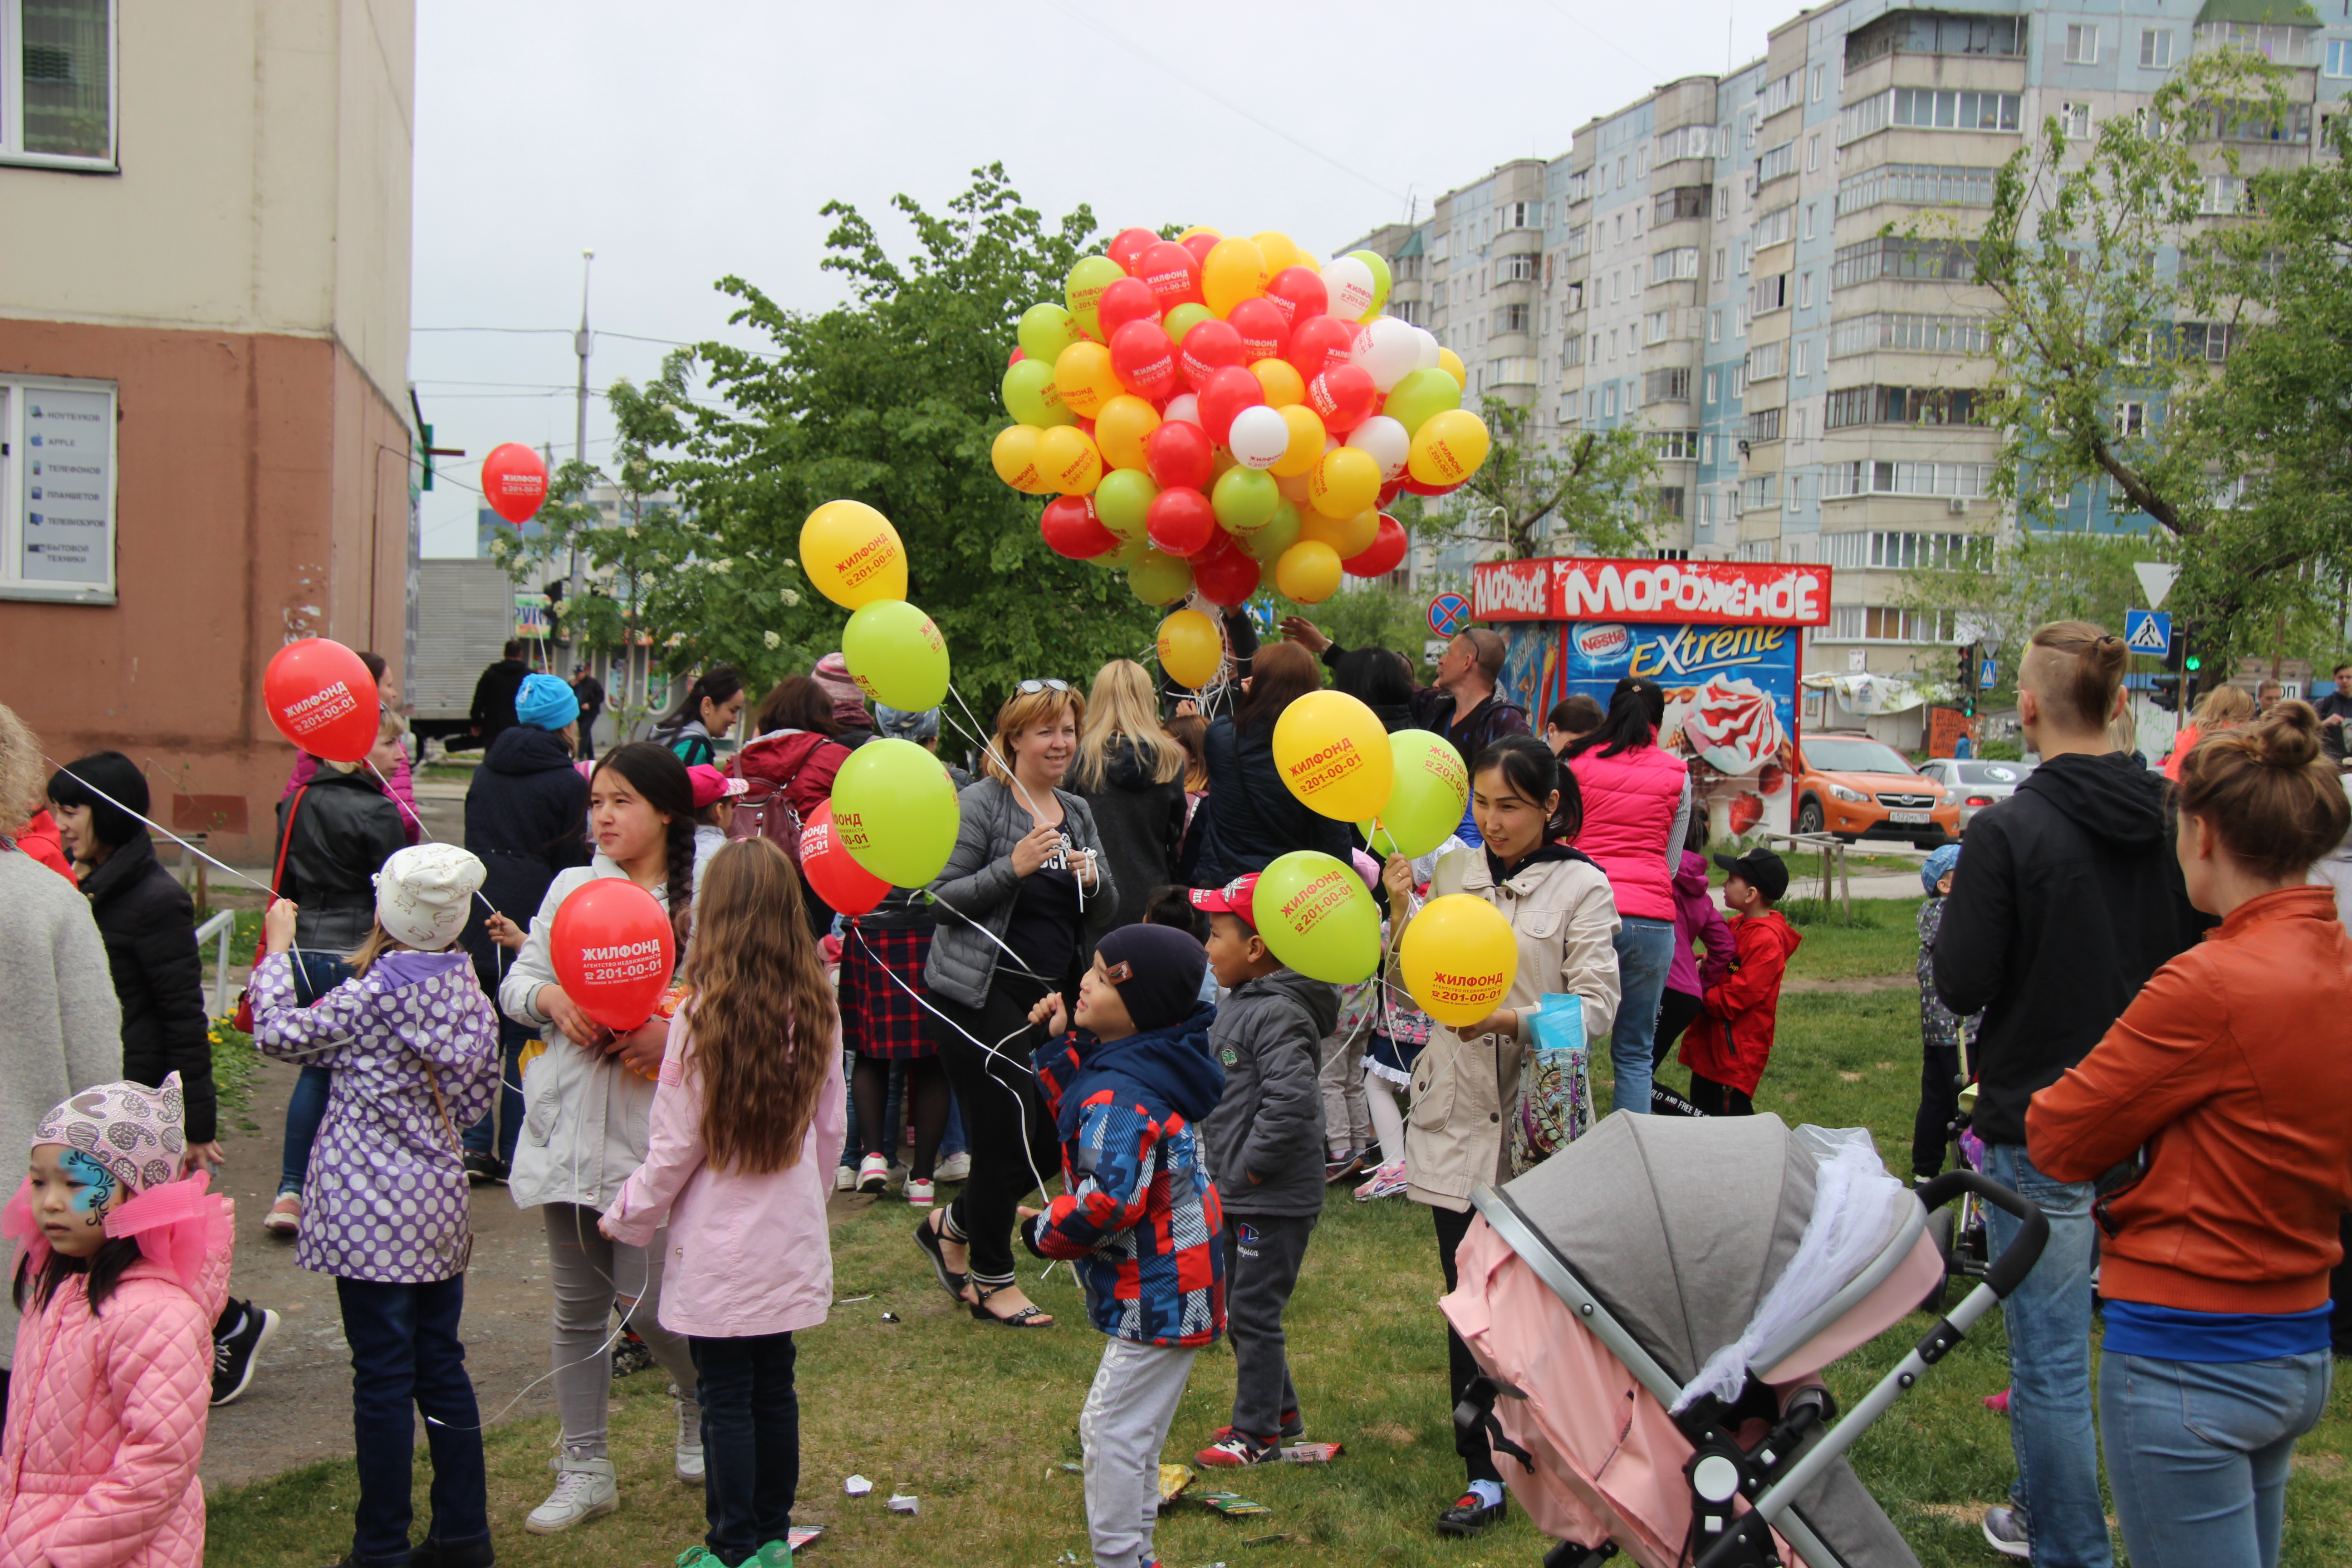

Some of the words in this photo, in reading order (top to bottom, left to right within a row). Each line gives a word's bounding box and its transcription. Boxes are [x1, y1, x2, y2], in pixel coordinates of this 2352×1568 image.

[1146, 270, 1188, 284] ЖИЛФОНД
[1155, 280, 1190, 294] 201-00-01
[1071, 286, 1106, 299] ЖИЛФОН
[1132, 355, 1171, 376] ЖИЛФОНД
[1182, 349, 1214, 373] ЖИЛФОН
[1142, 365, 1173, 384] 201-00-01
[1318, 372, 1338, 411] ЖИЛФОНД
[48, 412, 100, 422] НОУТБУКОВ
[49, 438, 76, 447] APPLE
[1060, 447, 1090, 479] ЖИЛФОНД
[1431, 450, 1454, 479] 201-00-01
[1437, 438, 1464, 475] ЖИЛФОНД
[48, 464, 101, 475] ТЕЛЕФОНОВ
[502, 474, 542, 484] ЖИЛФОНД
[1072, 454, 1095, 482] 201-00-01
[48, 490, 100, 501] ПЛАНШЕТОВ
[48, 517, 105, 528] ТЕЛЕВИЗОРОВ
[47, 544, 89, 553] БЫТОВОЙ
[48, 554, 87, 563] ТЕХНИКИ
[835, 532, 889, 574] ЖИЛФОНД
[853, 545, 896, 582] 201-00-01
[1476, 565, 1546, 617] МОРОЖЕНОЕ
[1565, 564, 1819, 620] МОРОЖЕНОЕ
[284, 681, 348, 718] ЖИЛФОНД
[301, 695, 356, 729] 201-00-01
[1289, 737, 1354, 778] ЖИЛФОНД
[1427, 754, 1454, 771] АГЕНТСТВО
[1429, 745, 1469, 783] ЖИЛФО
[1305, 753, 1361, 789] 201-00-01
[1422, 765, 1441, 778] Главное
[1435, 763, 1467, 808] 201-00-0
[1280, 871, 1344, 919] ЖИЛФОНД
[1289, 902, 1312, 924] АГЕНТСТВО
[1312, 880, 1347, 903] НЕДВИЖИМОСТИ
[1301, 884, 1353, 926] 201-00-01
[1300, 922, 1316, 937] Главное
[1319, 909, 1332, 921] жизни
[1333, 900, 1346, 909] семья
[582, 939, 661, 961] ЖИЛФОНД
[617, 953, 661, 966] НЕДВИЖИМОСТИ
[596, 958, 662, 980] 201-00-01
[1434, 971, 1503, 987] ЖИЛФОНД
[1432, 984, 1462, 993] АГЕНТСТВО
[1463, 984, 1502, 994] НЕДВИЖИМОСТИ
[1441, 989, 1501, 1002] 201-00-01
[1664, 1095, 1678, 1105] AND
[1677, 1100, 1694, 1114] FREE
